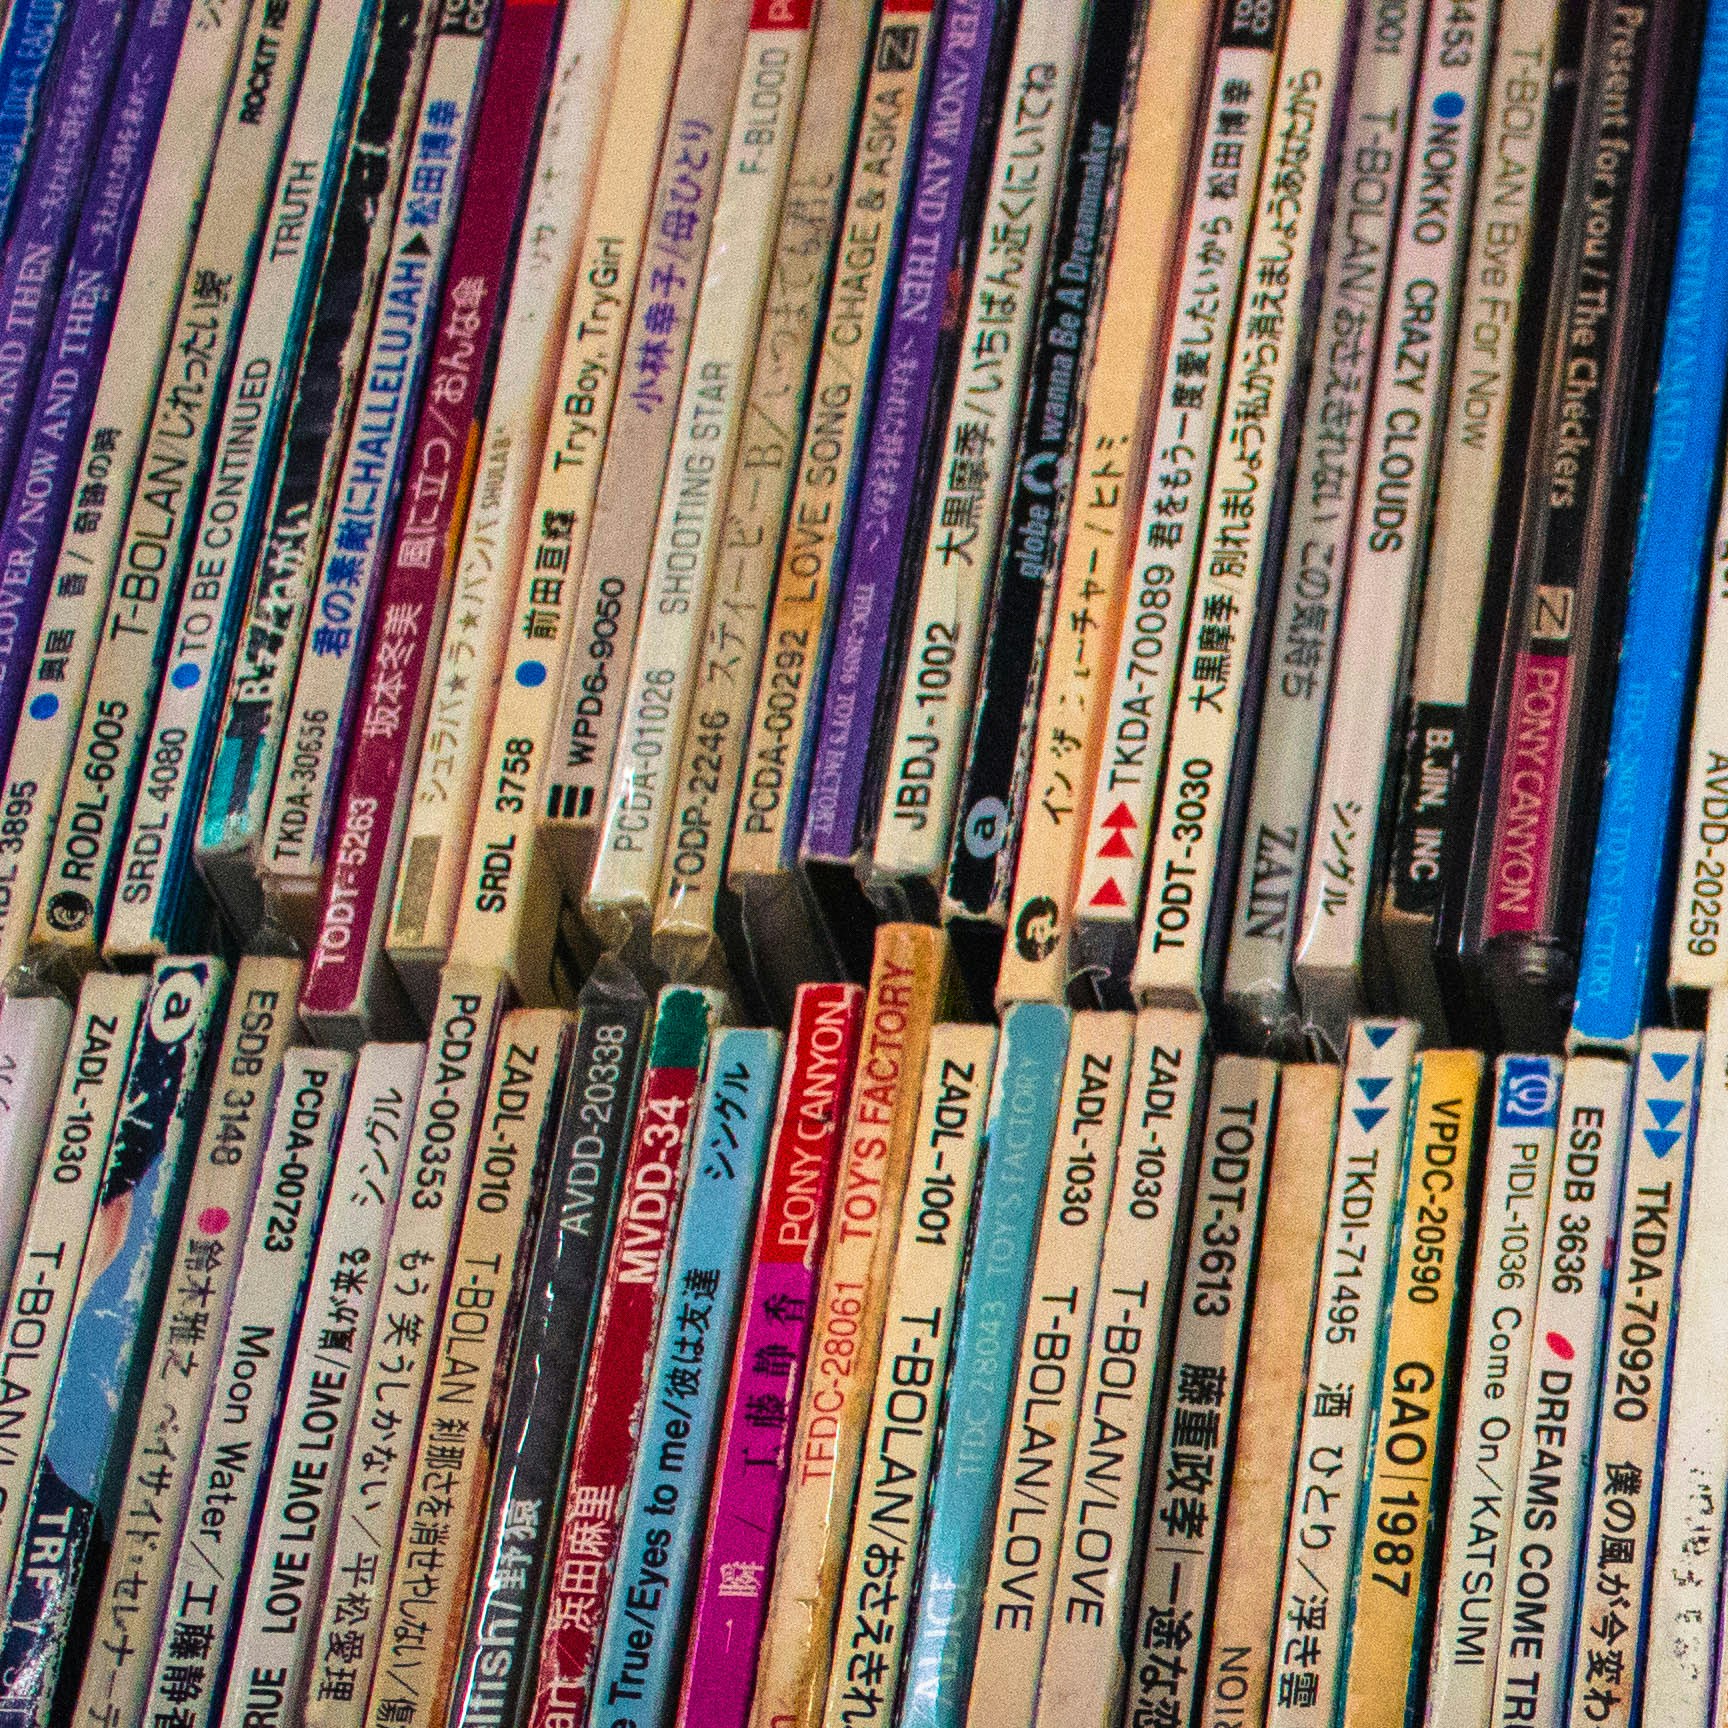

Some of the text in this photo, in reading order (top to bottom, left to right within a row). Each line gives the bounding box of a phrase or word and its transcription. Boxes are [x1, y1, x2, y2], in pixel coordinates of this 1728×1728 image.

[271, 159, 318, 263] TRUTH
[204, 356, 272, 556] CONTINUED
[1325, 122, 1459, 916] NOKKO シングル
[1108, 564, 1175, 790] TKDA-70089
[61, 700, 128, 883] RODL-6005
[275, 709, 328, 863] TKDA-30656
[1154, 757, 1214, 955] TODT-3030
[1496, 757, 1548, 916] CANYON
[315, 796, 379, 970] TODT-5263
[1246, 824, 1297, 942] ZAIN
[55, 1015, 117, 1183] ZADL-1030
[264, 1068, 328, 1254] PCDA-00723
[411, 994, 480, 1210] PCDA-00353
[478, 1045, 538, 1214] ZADL-1010
[560, 1024, 627, 1236] AVDD-20338
[620, 1094, 683, 1284] MVDD-34
[703, 1059, 750, 1182] シングル
[914, 1058, 976, 1247] ZADL-1001
[1059, 1053, 1112, 1226] ZADL-1030
[1128, 1045, 1181, 1222] ZADL-1030
[1200, 1098, 1256, 1318] TODT-3613
[1322, 1147, 1378, 1344] TKDI-71495
[1405, 1098, 1464, 1304] VPDC-20590
[1495, 1143, 1538, 1290] PIDL-1036
[443, 1252, 503, 1406] T-BOLAN
[801, 1280, 866, 1486] TFDC-28061
[1612, 1182, 1670, 1422] TKDA-70920
[994, 1285, 1078, 1632] T-BOLAN/LOVE
[1065, 1282, 1146, 1629] T-BOLAN/LOVE
